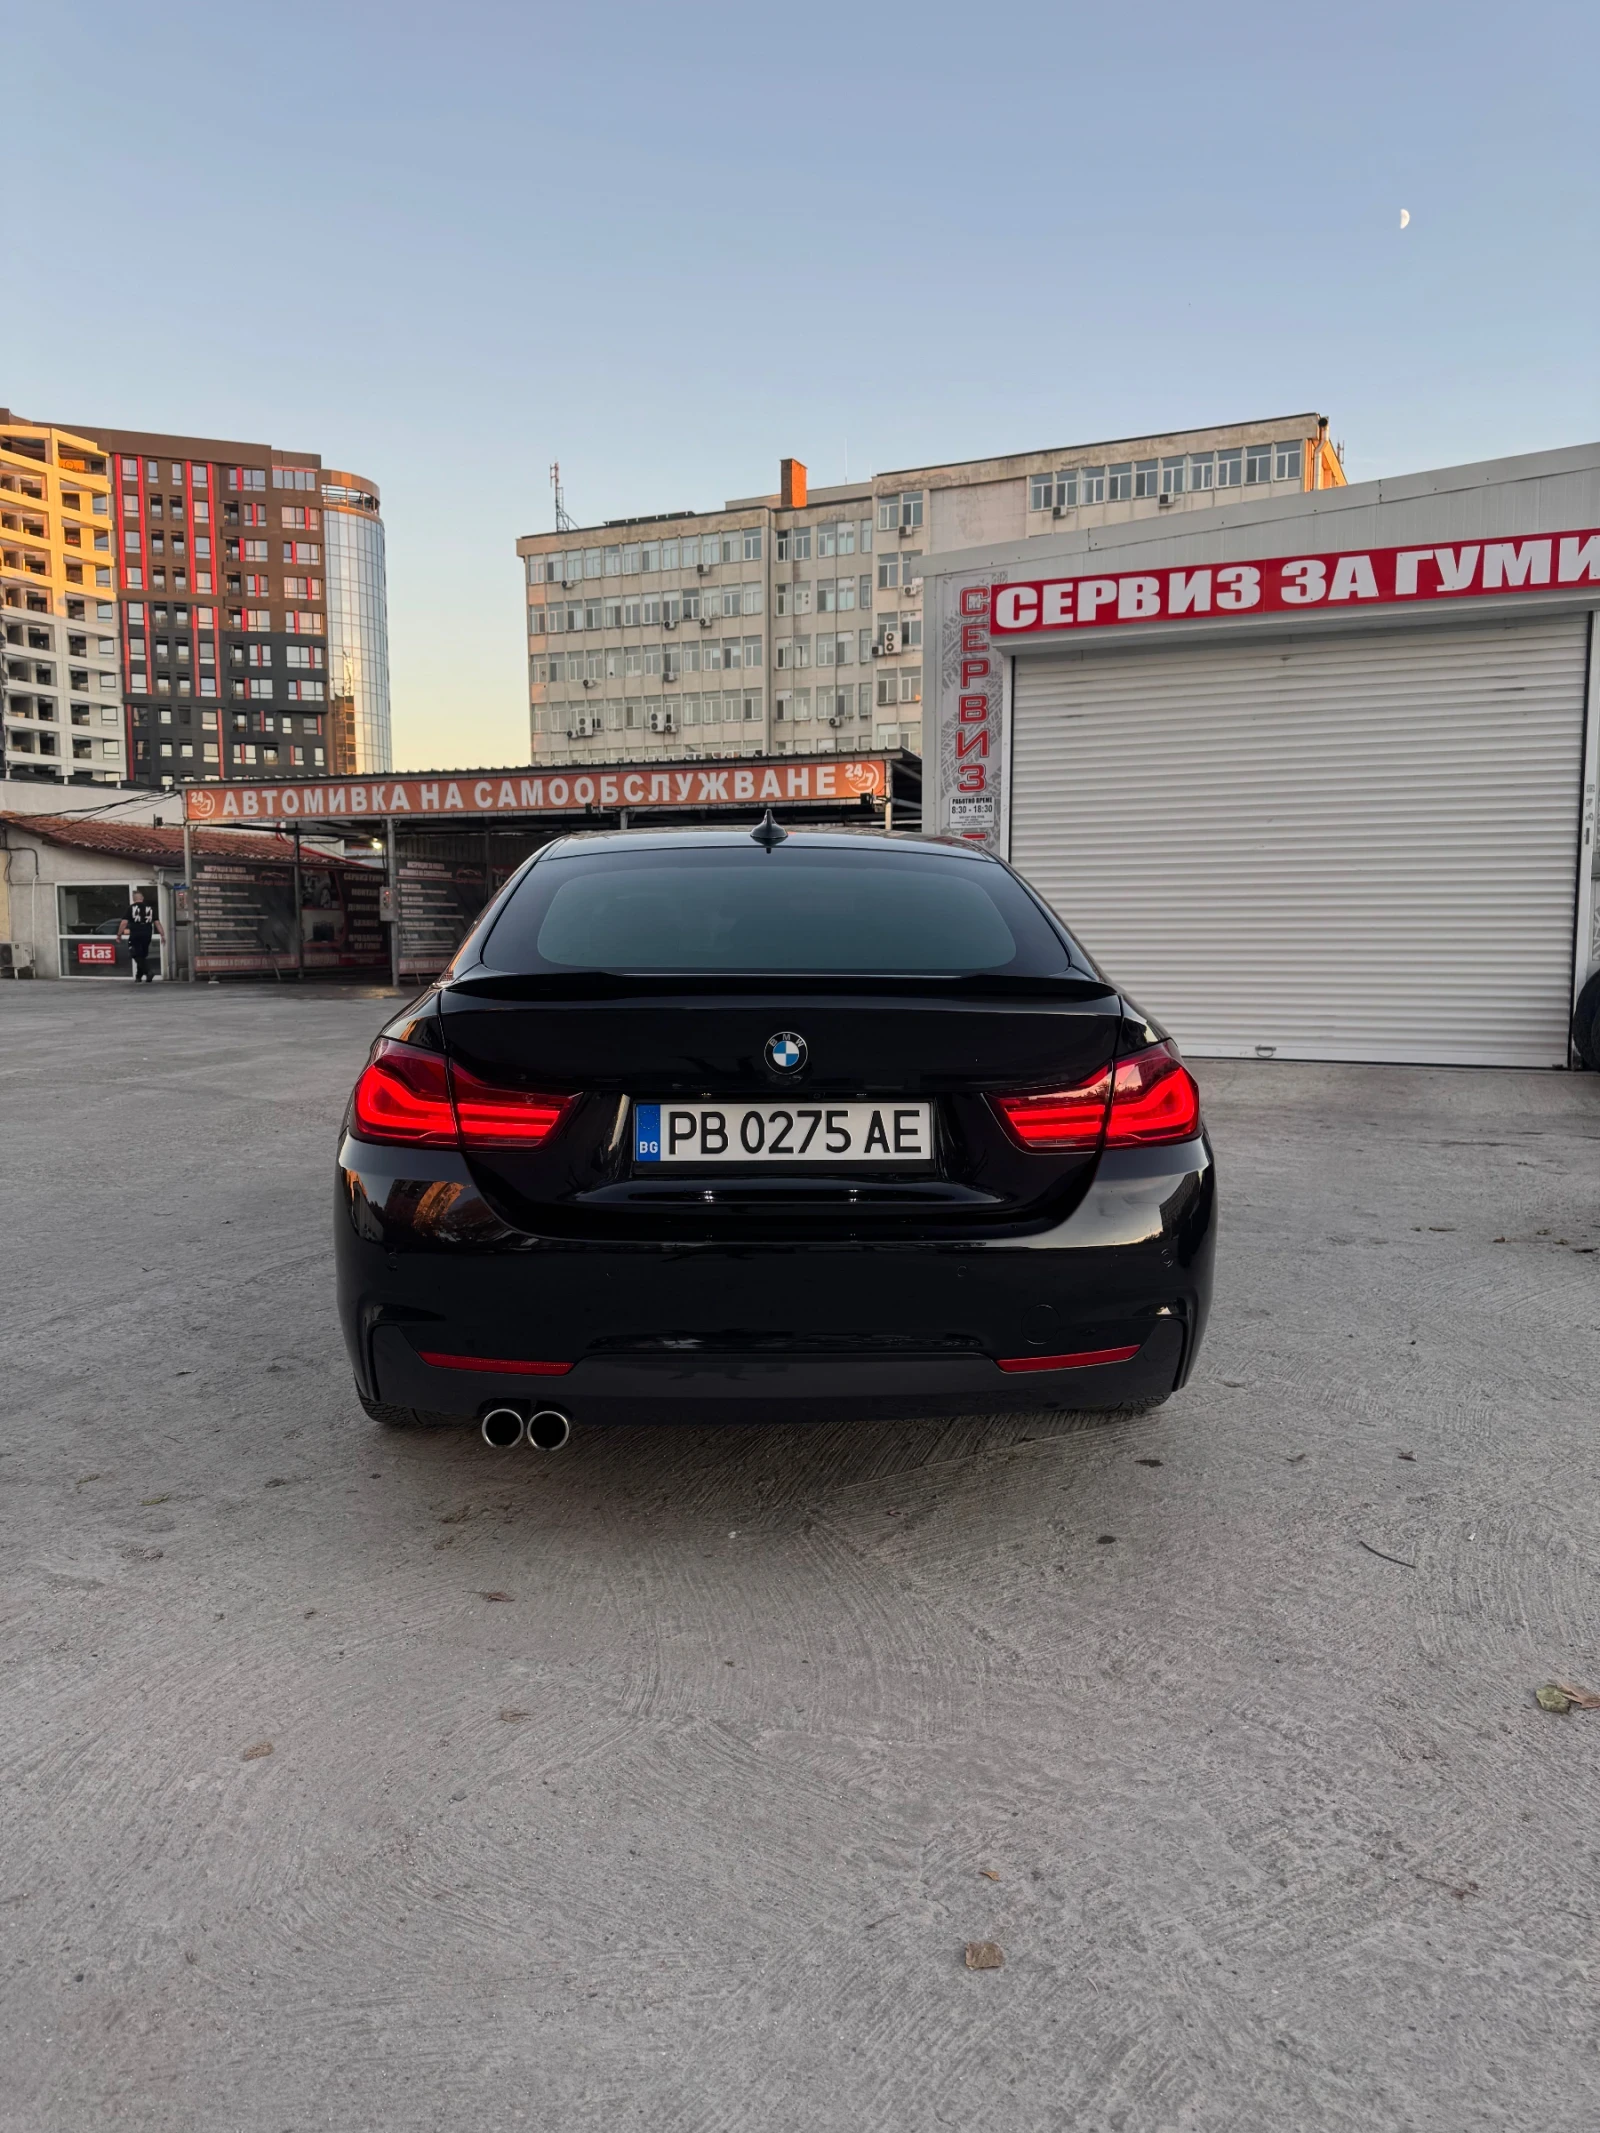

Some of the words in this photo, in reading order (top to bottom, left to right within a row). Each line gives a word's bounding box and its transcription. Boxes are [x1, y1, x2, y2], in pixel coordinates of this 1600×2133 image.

[995, 565, 1261, 629] СЕРВИЗ
[1280, 555, 1380, 605] ЗА
[956, 586, 991, 793] СЕРВИЗ
[222, 784, 411, 816] АВТОМИВКА
[420, 782, 464, 810] НА
[474, 766, 837, 808] САМООБСЛУЖВАНЕ
[952, 797, 976, 805] РАБОТНО
[976, 796, 993, 804] ВРЕМЕ
[951, 805, 967, 814] 8:30
[973, 804, 993, 813] 18:30
[82, 944, 112, 959] atas
[768, 1033, 806, 1048] BMW
[668, 1111, 729, 1155] PB
[740, 1110, 852, 1154] 0275
[863, 1109, 923, 1154] AE
[639, 1141, 659, 1154] BG
